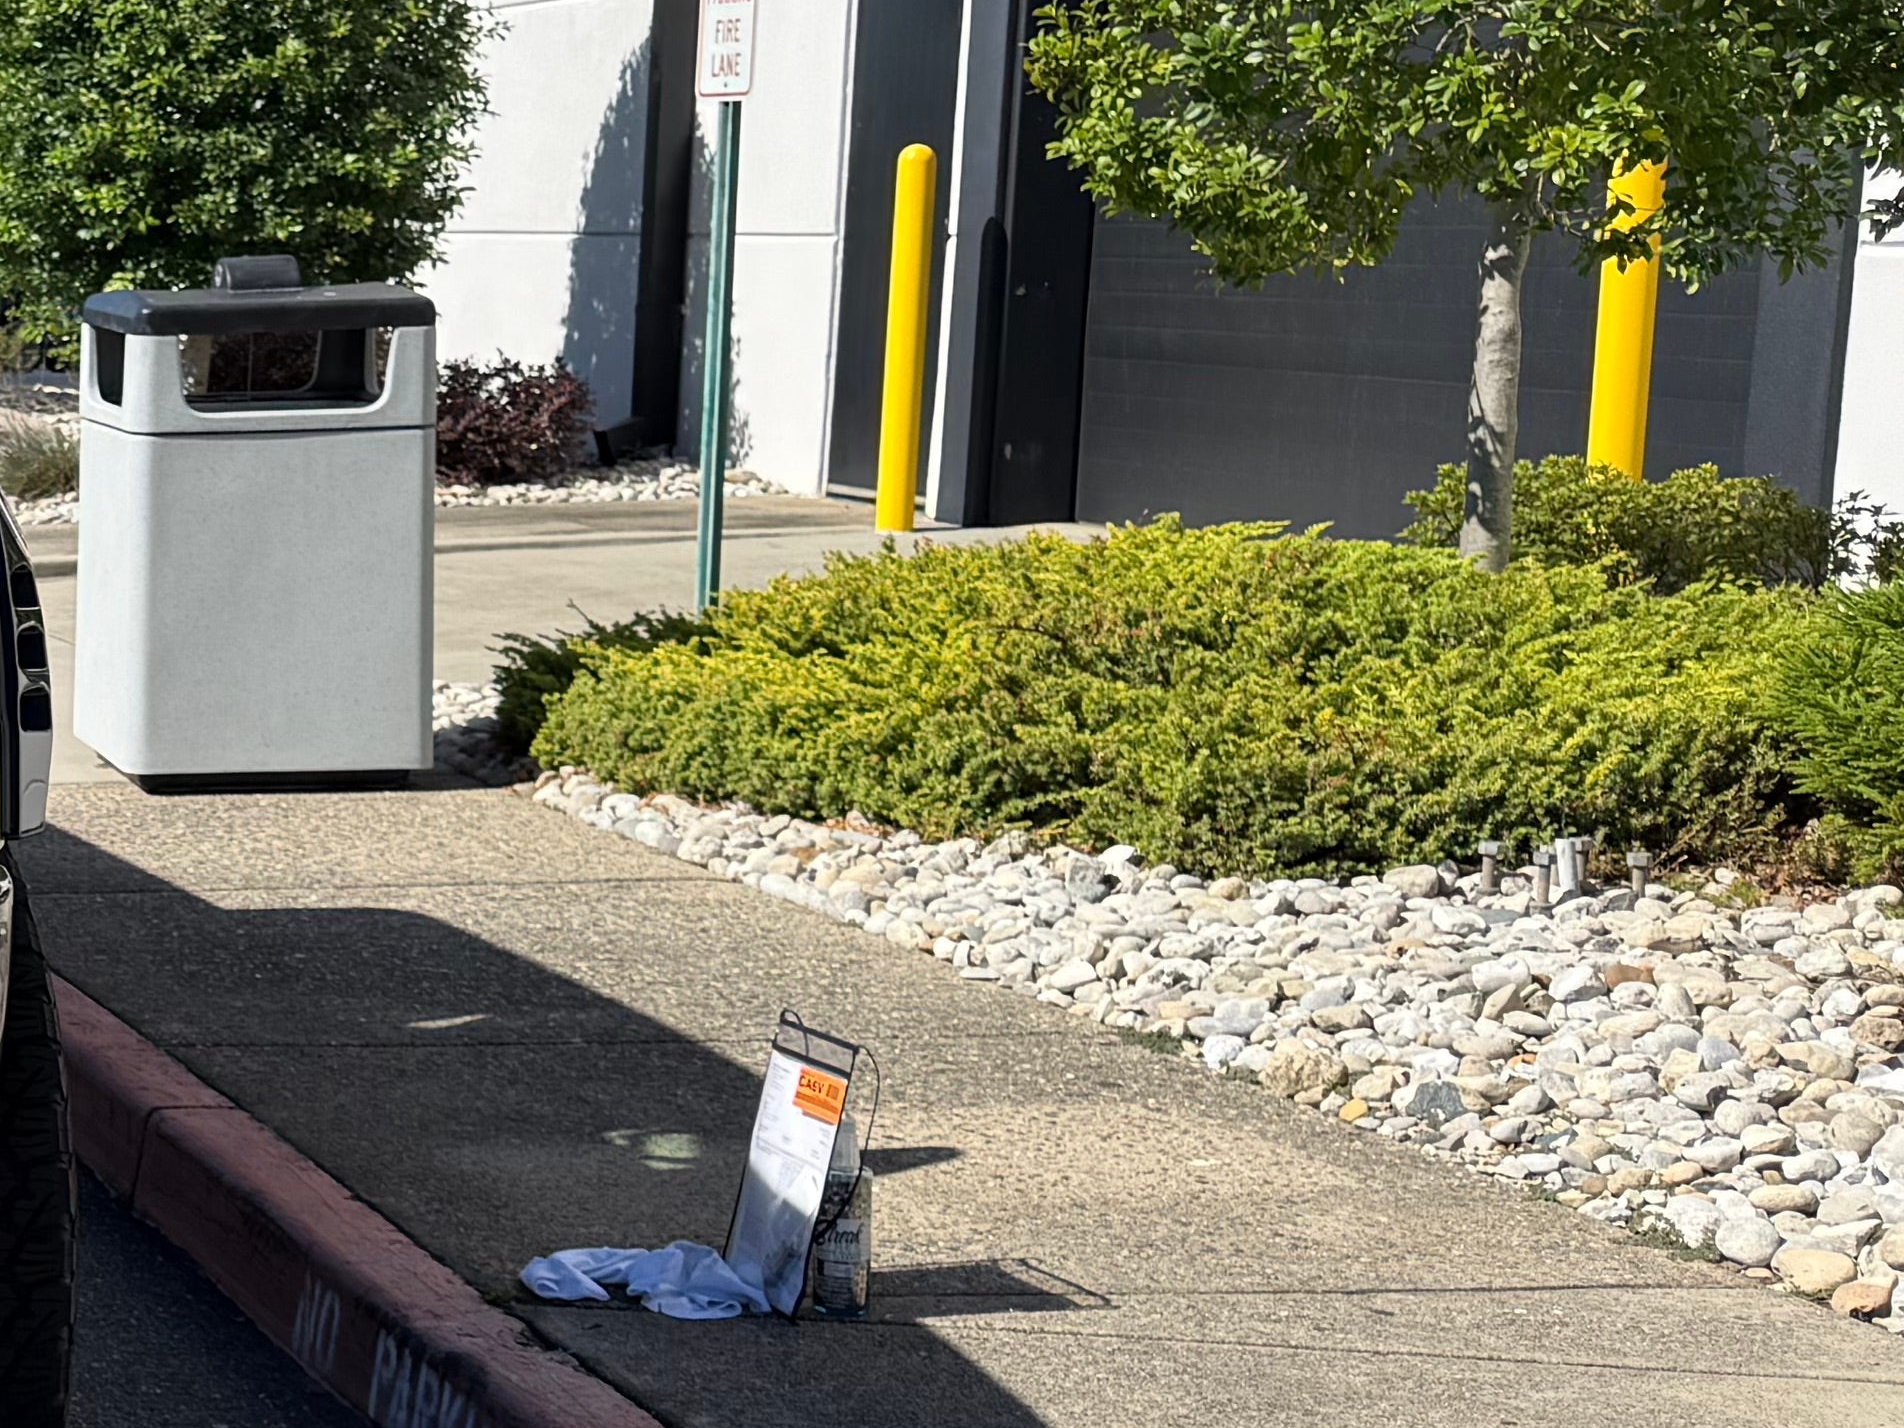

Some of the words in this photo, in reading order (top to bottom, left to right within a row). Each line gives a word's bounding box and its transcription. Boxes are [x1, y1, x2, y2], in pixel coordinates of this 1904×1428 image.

[716, 19, 741, 43] FIRE
[712, 53, 741, 77] LANE
[290, 1271, 341, 1373] NO
